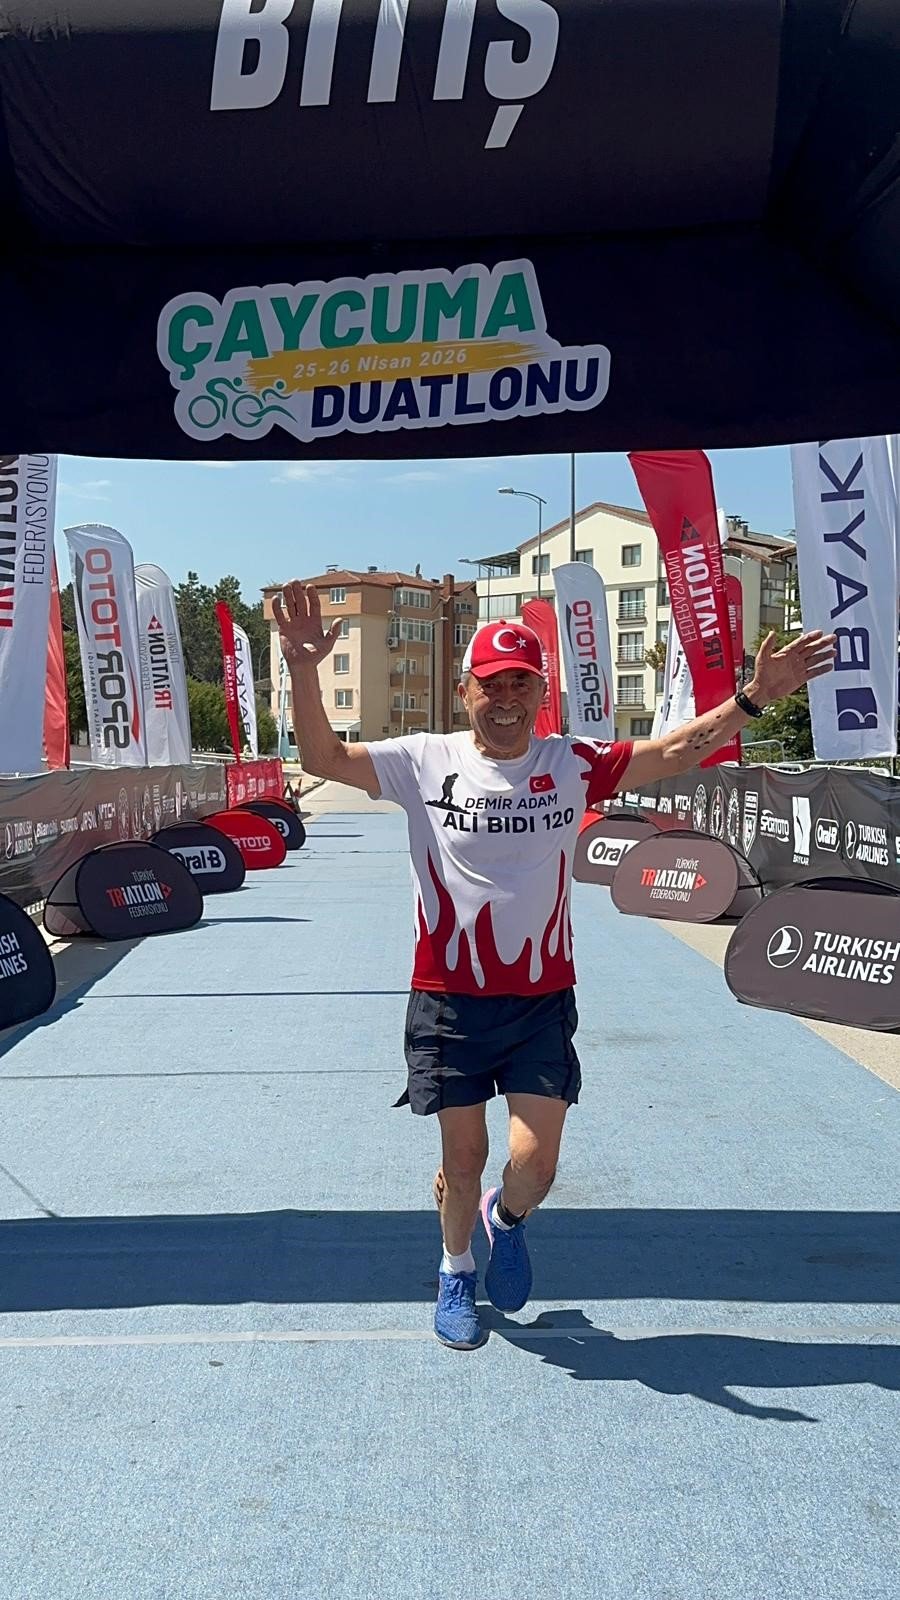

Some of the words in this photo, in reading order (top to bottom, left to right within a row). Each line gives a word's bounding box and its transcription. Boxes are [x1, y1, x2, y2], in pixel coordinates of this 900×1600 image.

[167, 271, 536, 381] ÇAYCUMA
[293, 358, 350, 379] 25-26
[357, 354, 411, 372] Nisan
[420, 348, 468, 368] 2026
[311, 357, 600, 428] DUATLONU
[23, 454, 50, 584] FEDERASYONU
[464, 795, 513, 810] DEMİR
[516, 793, 558, 810] ADAM
[442, 811, 478, 833] ALİ
[487, 816, 535, 834] BIDI
[542, 807, 574, 831] 120
[858, 823, 888, 846] TURKISH
[592, 841, 629, 862] Oral
[855, 843, 889, 866] AIRLINES
[813, 931, 900, 962] TURKISH
[801, 953, 895, 985] AIRLINES
